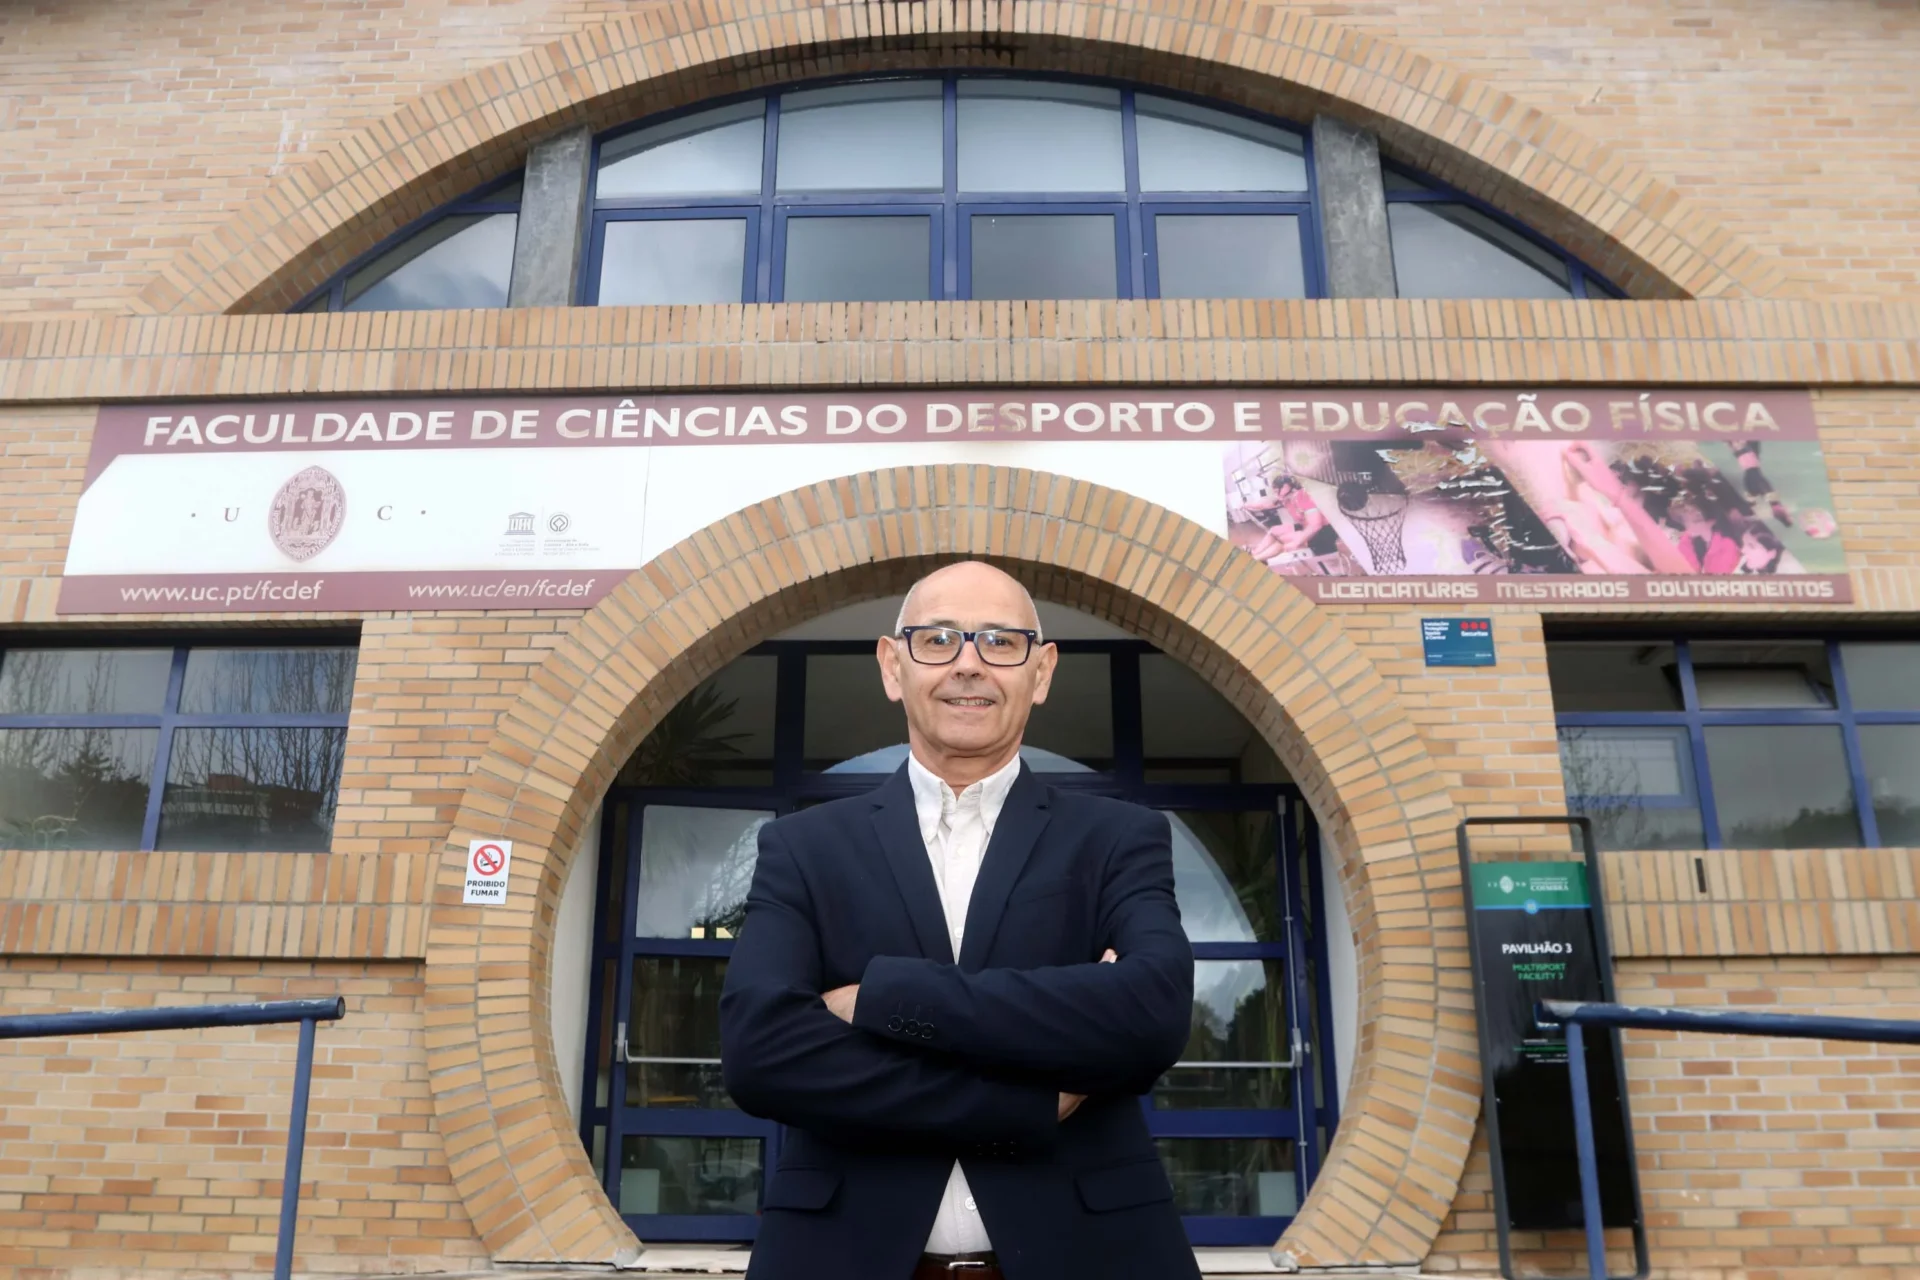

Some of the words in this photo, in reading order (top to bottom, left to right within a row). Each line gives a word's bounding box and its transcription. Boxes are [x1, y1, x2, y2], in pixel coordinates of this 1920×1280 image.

[143, 411, 455, 446] FACULDADE
[470, 409, 540, 440] DE
[556, 399, 809, 439] CIÊNCIAS
[826, 403, 907, 434] DO
[926, 402, 1215, 433] DESPORTO
[1234, 402, 1262, 432] E
[1279, 393, 1591, 437] EDUCAÇÃO
[1608, 393, 1780, 432] FÍSICA
[224, 507, 240, 523] U
[377, 505, 393, 521] C
[120, 580, 324, 606] www.uc.pt/fcdef
[408, 578, 595, 598] www.uc/en/fcdef
[1318, 582, 1479, 598] LICENCIATURAS
[1497, 581, 1629, 598] MESTRADOS
[1647, 581, 1834, 597] DOUTORAMENTOS
[1501, 941, 1563, 954] PAVILHÃO
[1565, 943, 1573, 954] 3
[1512, 963, 1566, 972] MULTISPORT
[1517, 972, 1556, 981] FACILITY
